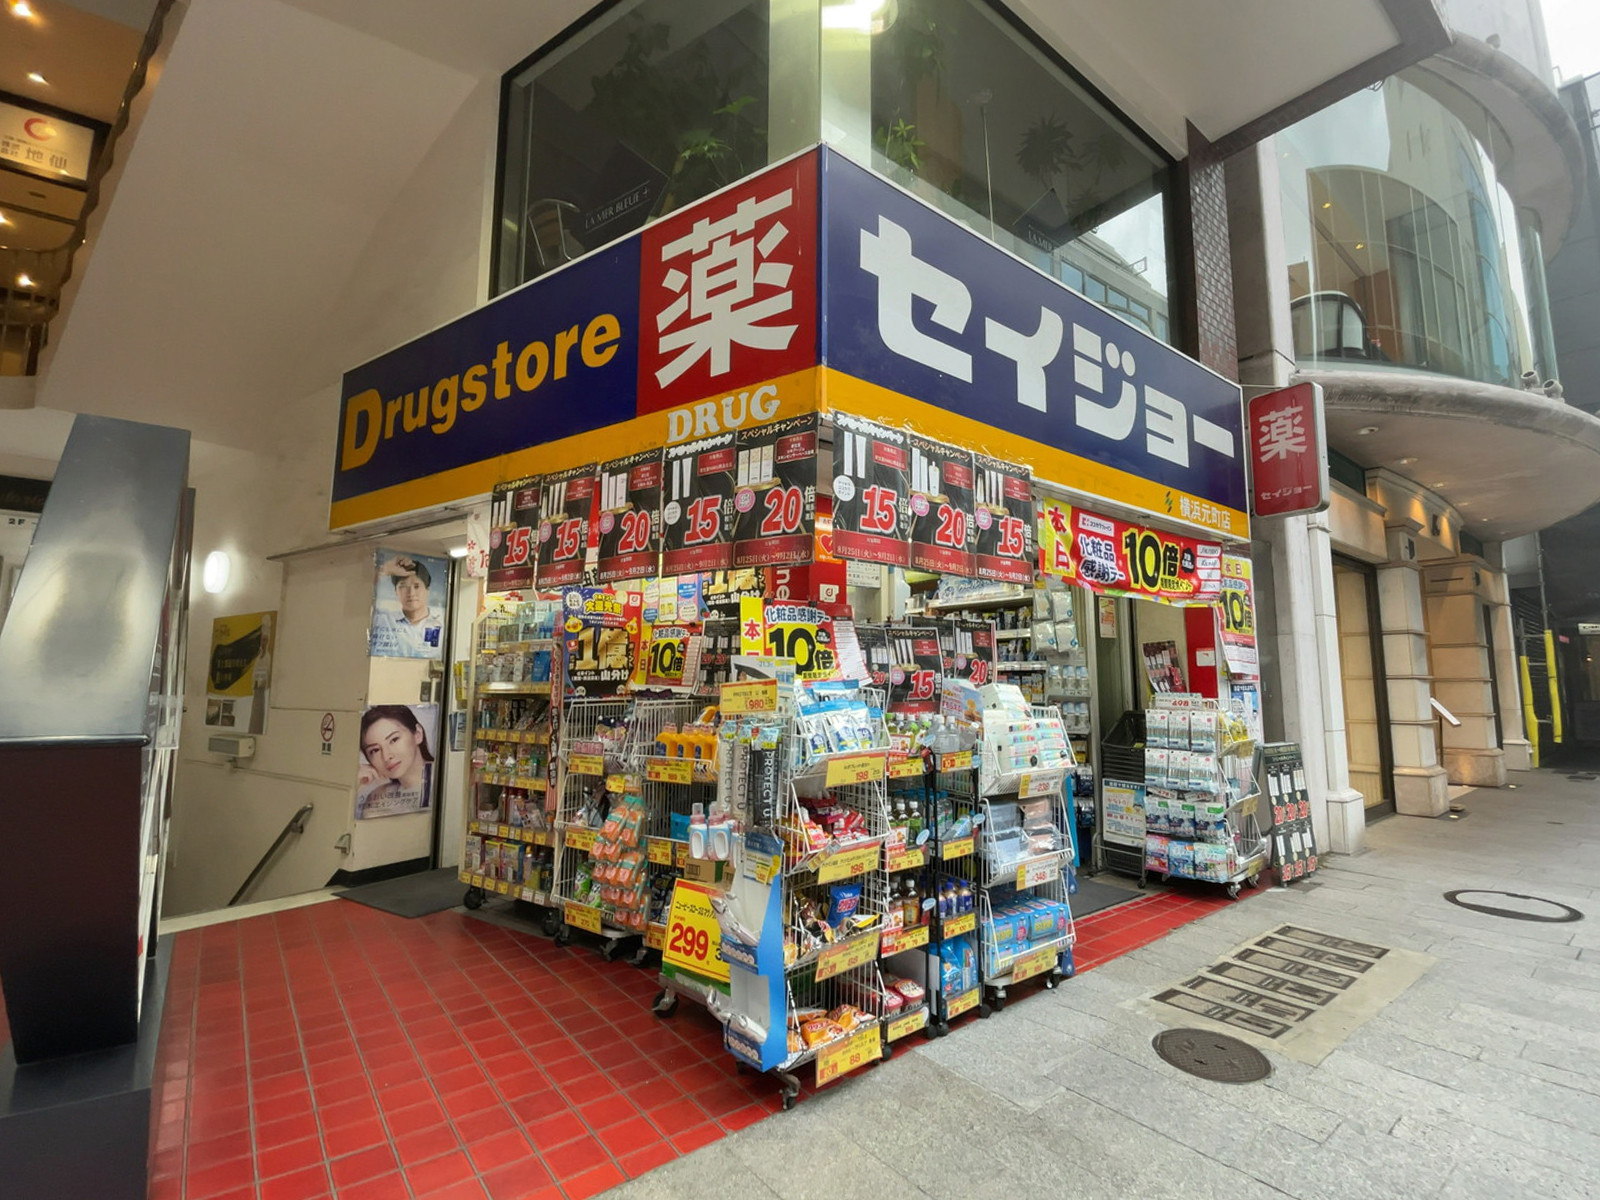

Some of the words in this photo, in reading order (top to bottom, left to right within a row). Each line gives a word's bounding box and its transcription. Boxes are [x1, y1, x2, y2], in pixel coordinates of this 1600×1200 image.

[655, 189, 798, 389] 薬
[859, 214, 1234, 468] セイジョー
[340, 312, 621, 471] Drugstore
[667, 385, 781, 444] DRUG
[741, 416, 814, 440] スペシャルキャンペーン
[1258, 405, 1308, 463] 薬
[1260, 484, 1312, 500] セイジョー
[1180, 496, 1231, 530] 横浜元町店
[1048, 506, 1070, 570] 本日
[1080, 536, 1116, 562] 化粧品
[1080, 560, 1124, 581] 感謝デー
[766, 606, 830, 623] 化粧品感謝デー
[738, 746, 749, 796] PROTECT
[763, 751, 774, 806] PROTECT
[856, 772, 868, 781] 198
[850, 864, 864, 873] 198
[669, 922, 708, 962] 299
